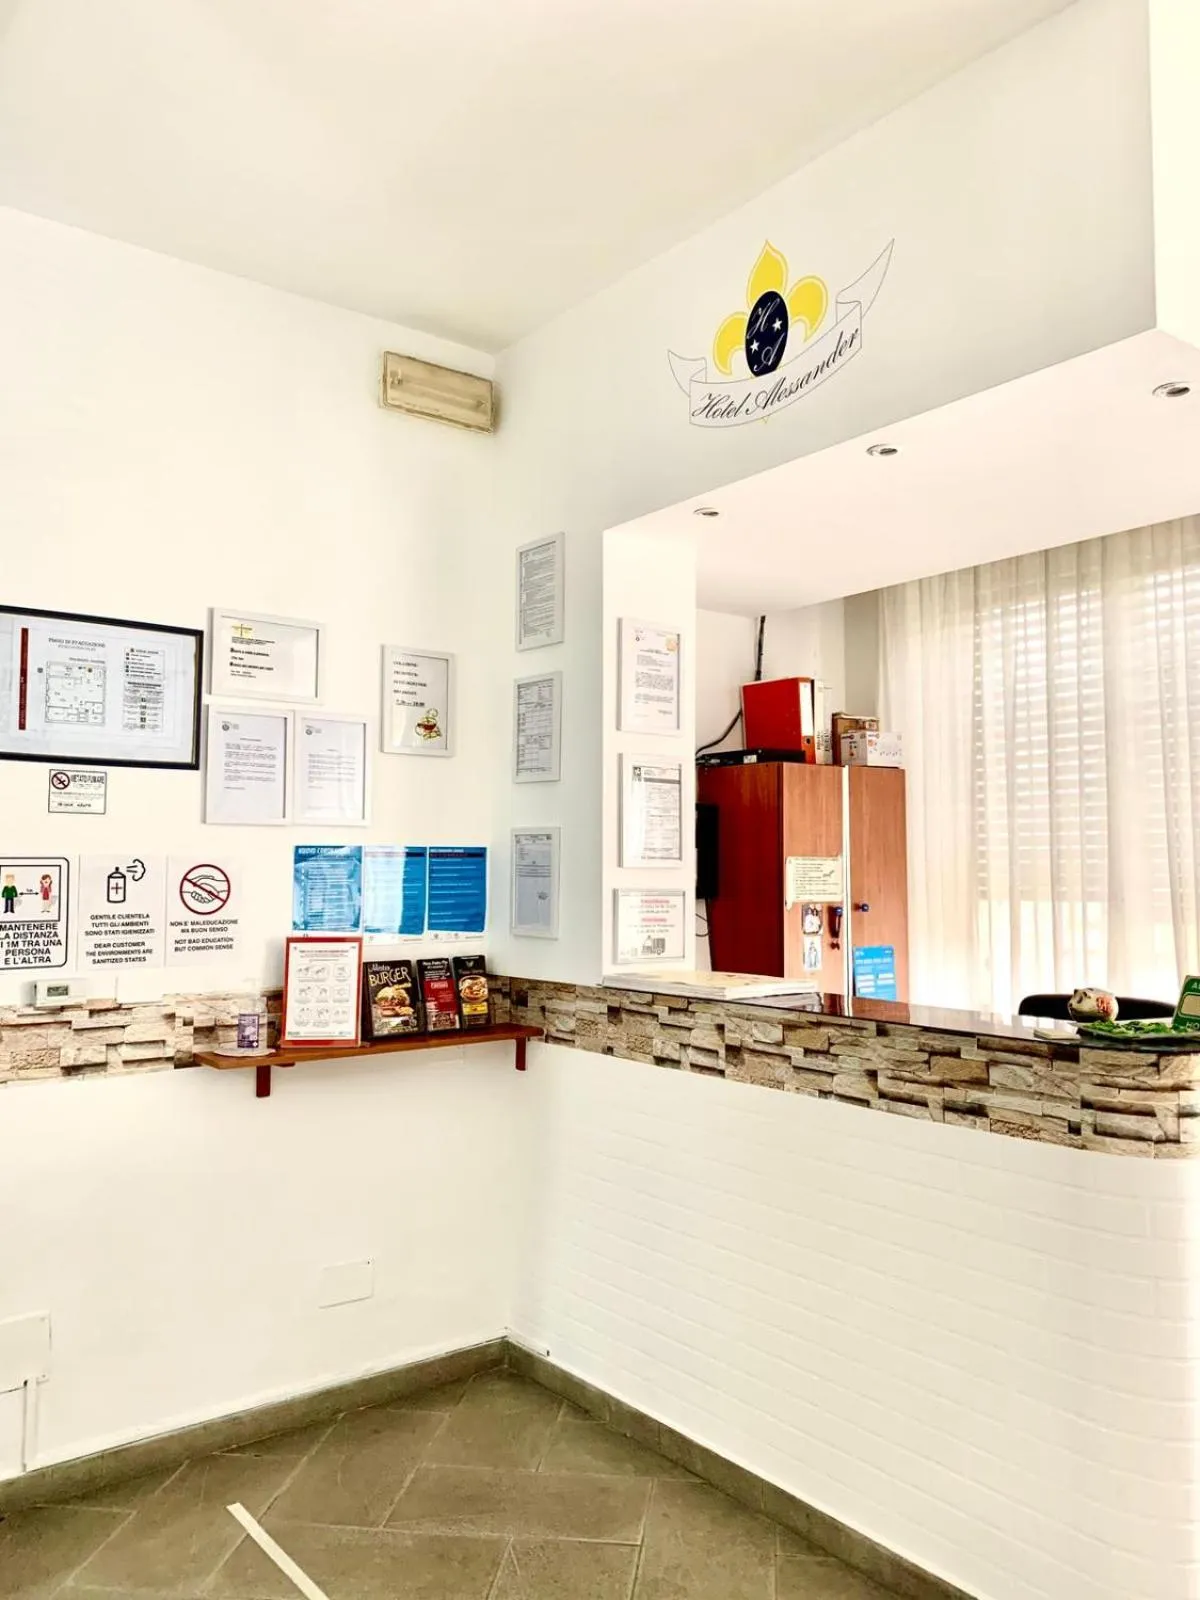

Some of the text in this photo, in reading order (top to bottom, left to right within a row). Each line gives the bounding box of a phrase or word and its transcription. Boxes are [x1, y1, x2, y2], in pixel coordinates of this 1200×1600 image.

[691, 328, 860, 419] Hotel Alessander
[0, 923, 59, 932] MANTENERE
[13, 931, 59, 939] DISTANZA
[7, 940, 19, 948] 1M
[5, 948, 50, 956] PERSONA
[13, 956, 51, 964] L'ALTRA
[368, 966, 412, 987] BURGER
